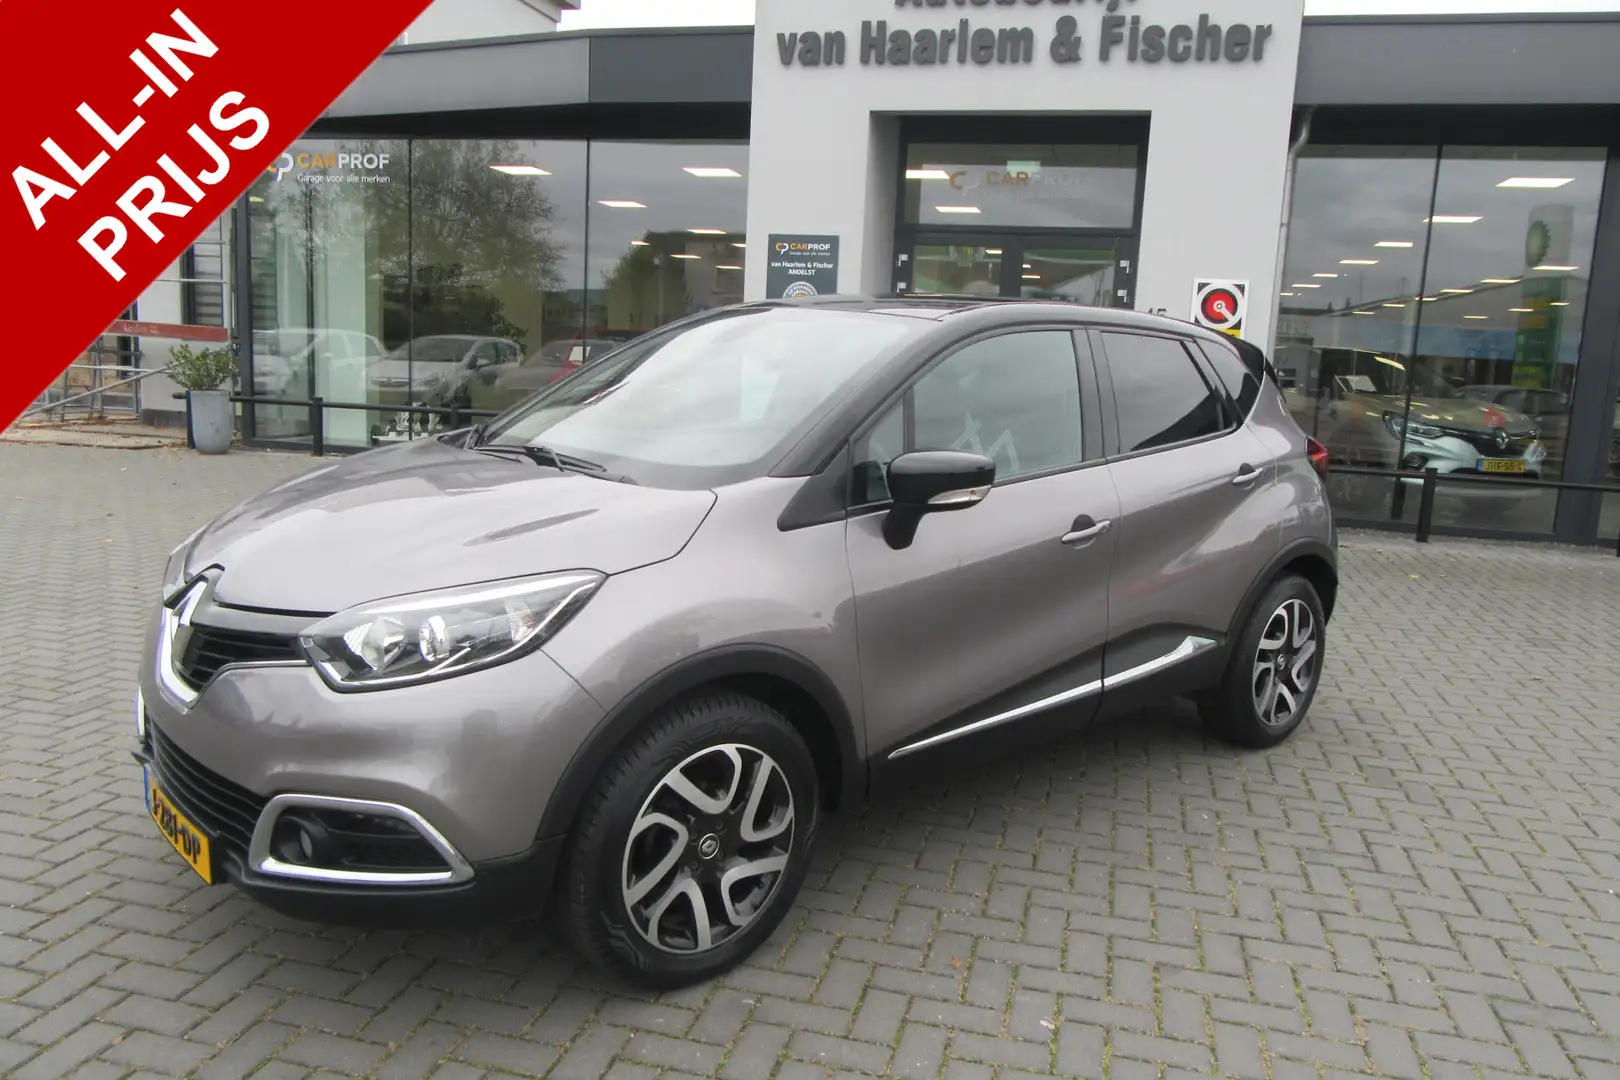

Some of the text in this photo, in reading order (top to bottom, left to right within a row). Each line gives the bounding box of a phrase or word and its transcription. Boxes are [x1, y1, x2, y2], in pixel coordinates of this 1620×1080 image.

[777, 14, 1272, 67] van Haarlem & Fischer
[297, 152, 390, 169] CARPROF
[297, 173, 324, 183] Garage
[346, 174, 360, 183] alle
[361, 174, 391, 183] merken
[790, 243, 831, 251] CARPROF
